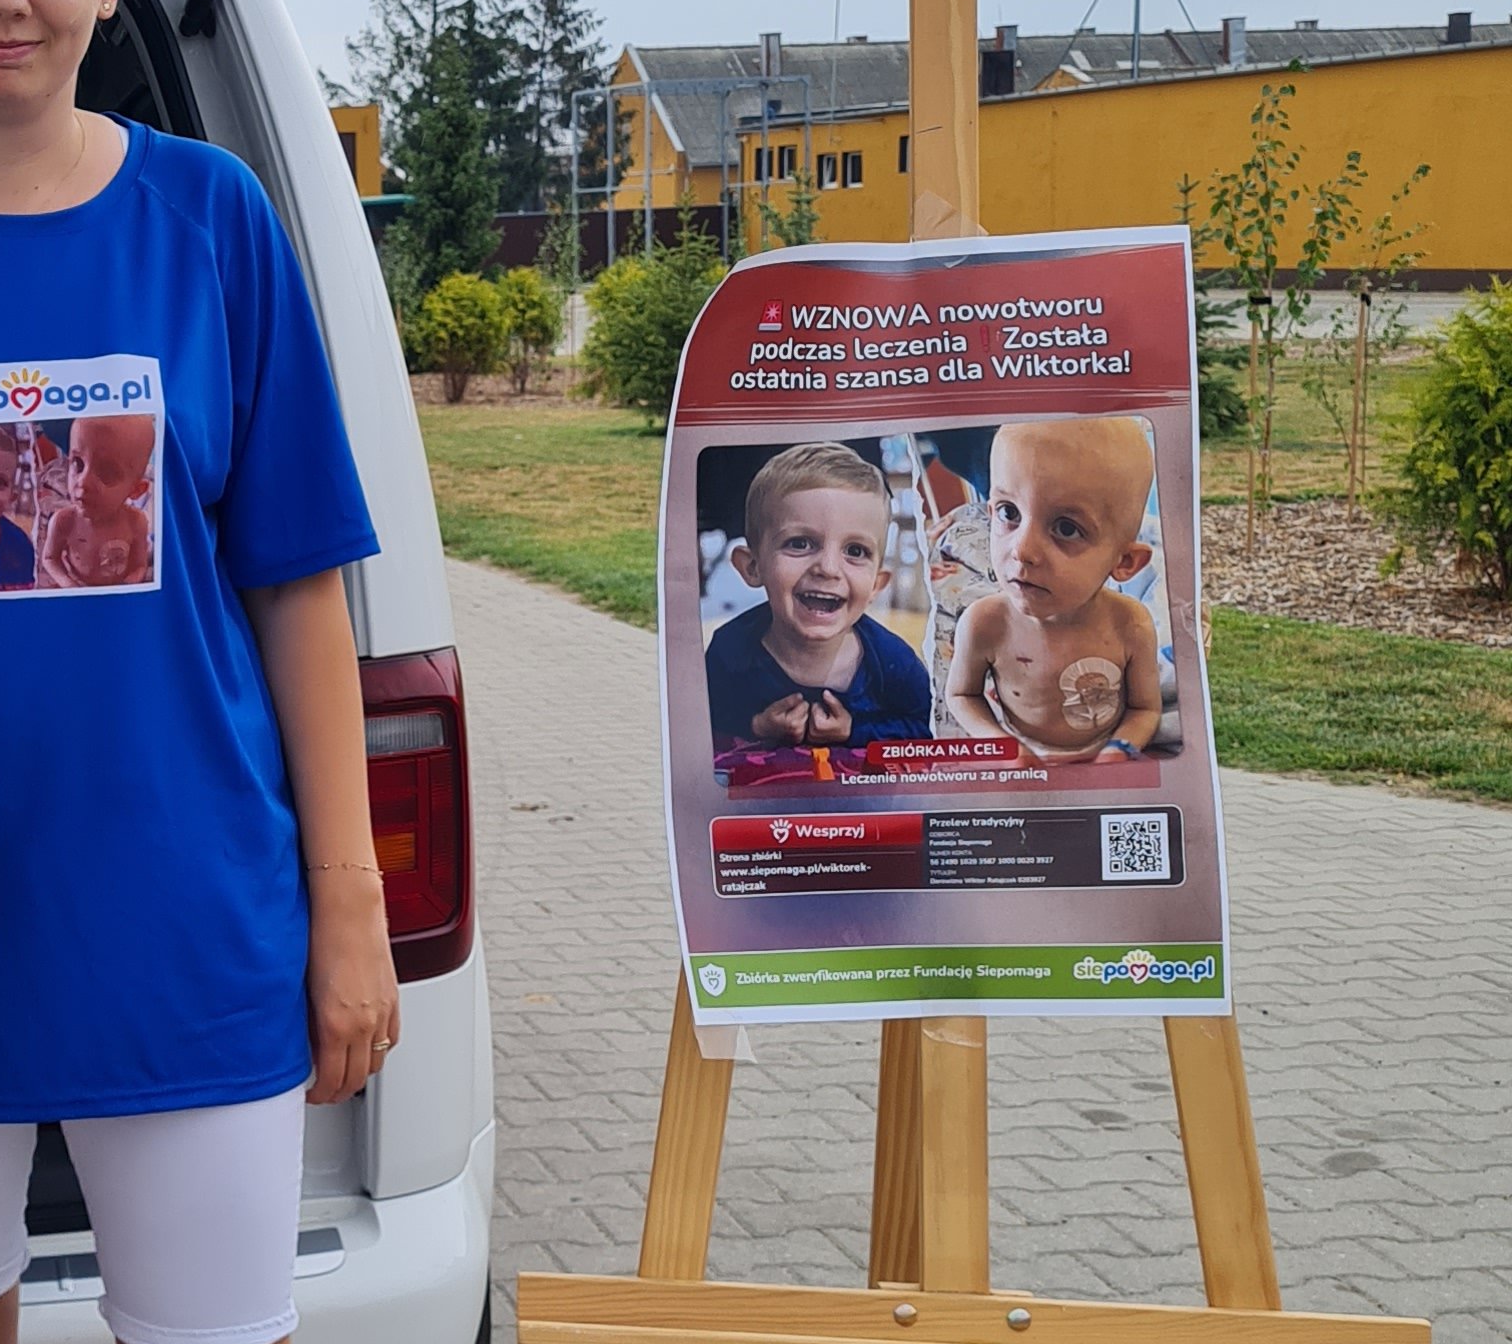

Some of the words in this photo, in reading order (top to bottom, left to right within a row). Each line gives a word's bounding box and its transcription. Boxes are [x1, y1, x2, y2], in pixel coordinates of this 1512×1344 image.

[791, 302, 931, 331] WZNOWA
[939, 296, 1103, 324] nowotworu
[750, 337, 846, 364] podczas
[854, 330, 967, 360] leczenia
[1002, 325, 1108, 350] Została
[730, 367, 827, 390] ostatnia
[835, 365, 929, 389] szansa
[938, 358, 983, 382] dla
[991, 350, 1131, 379] Wiktorka!
[882, 743, 945, 758] ZBIÓRKA
[949, 744, 970, 755] NA
[973, 743, 1004, 755] CEL:
[841, 772, 897, 785] Leczenie
[900, 771, 976, 783] nowotworu
[980, 770, 996, 781] za
[998, 767, 1048, 782] granicą
[929, 818, 969, 827] Przelew
[972, 816, 1025, 828] tradycyjny
[794, 823, 865, 839] Wesprzyj
[719, 853, 750, 863] Strona
[720, 863, 872, 877] www.siepomaga.pl/wiktorek-
[721, 880, 767, 894] ratajczak
[735, 972, 780, 986] Zbiórka
[783, 969, 873, 985] zweryfikowana
[876, 967, 911, 981] przez
[913, 965, 973, 980] Fundację
[976, 964, 1051, 979] Siepomaga
